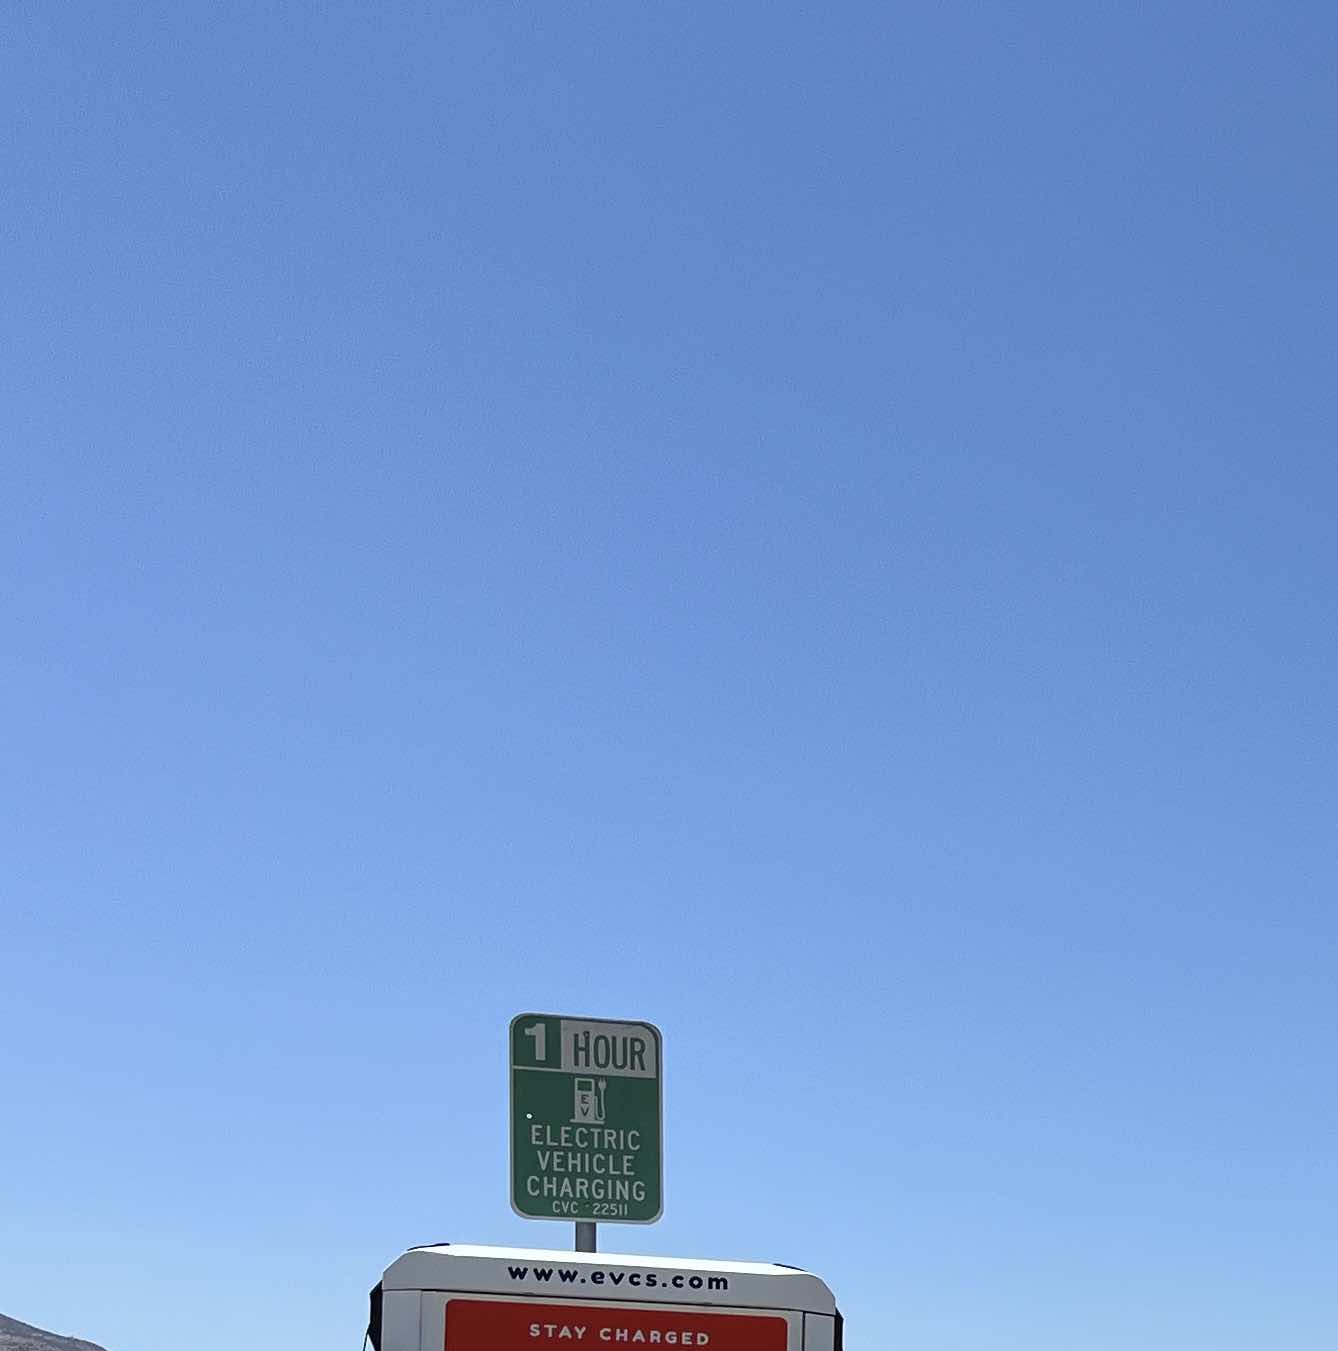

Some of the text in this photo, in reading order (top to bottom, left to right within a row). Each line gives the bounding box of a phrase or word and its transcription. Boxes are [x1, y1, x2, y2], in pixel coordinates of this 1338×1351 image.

[524, 1023, 647, 1071] 1 HOUR
[531, 1124, 641, 1151] ELECTRIC
[536, 1150, 636, 1176] VEHICLE
[527, 1175, 646, 1202] CHARGING
[552, 1200, 628, 1216] CVC 22511
[507, 1266, 729, 1290] www.evcs.com
[529, 1323, 710, 1345] STAY CHARGED
